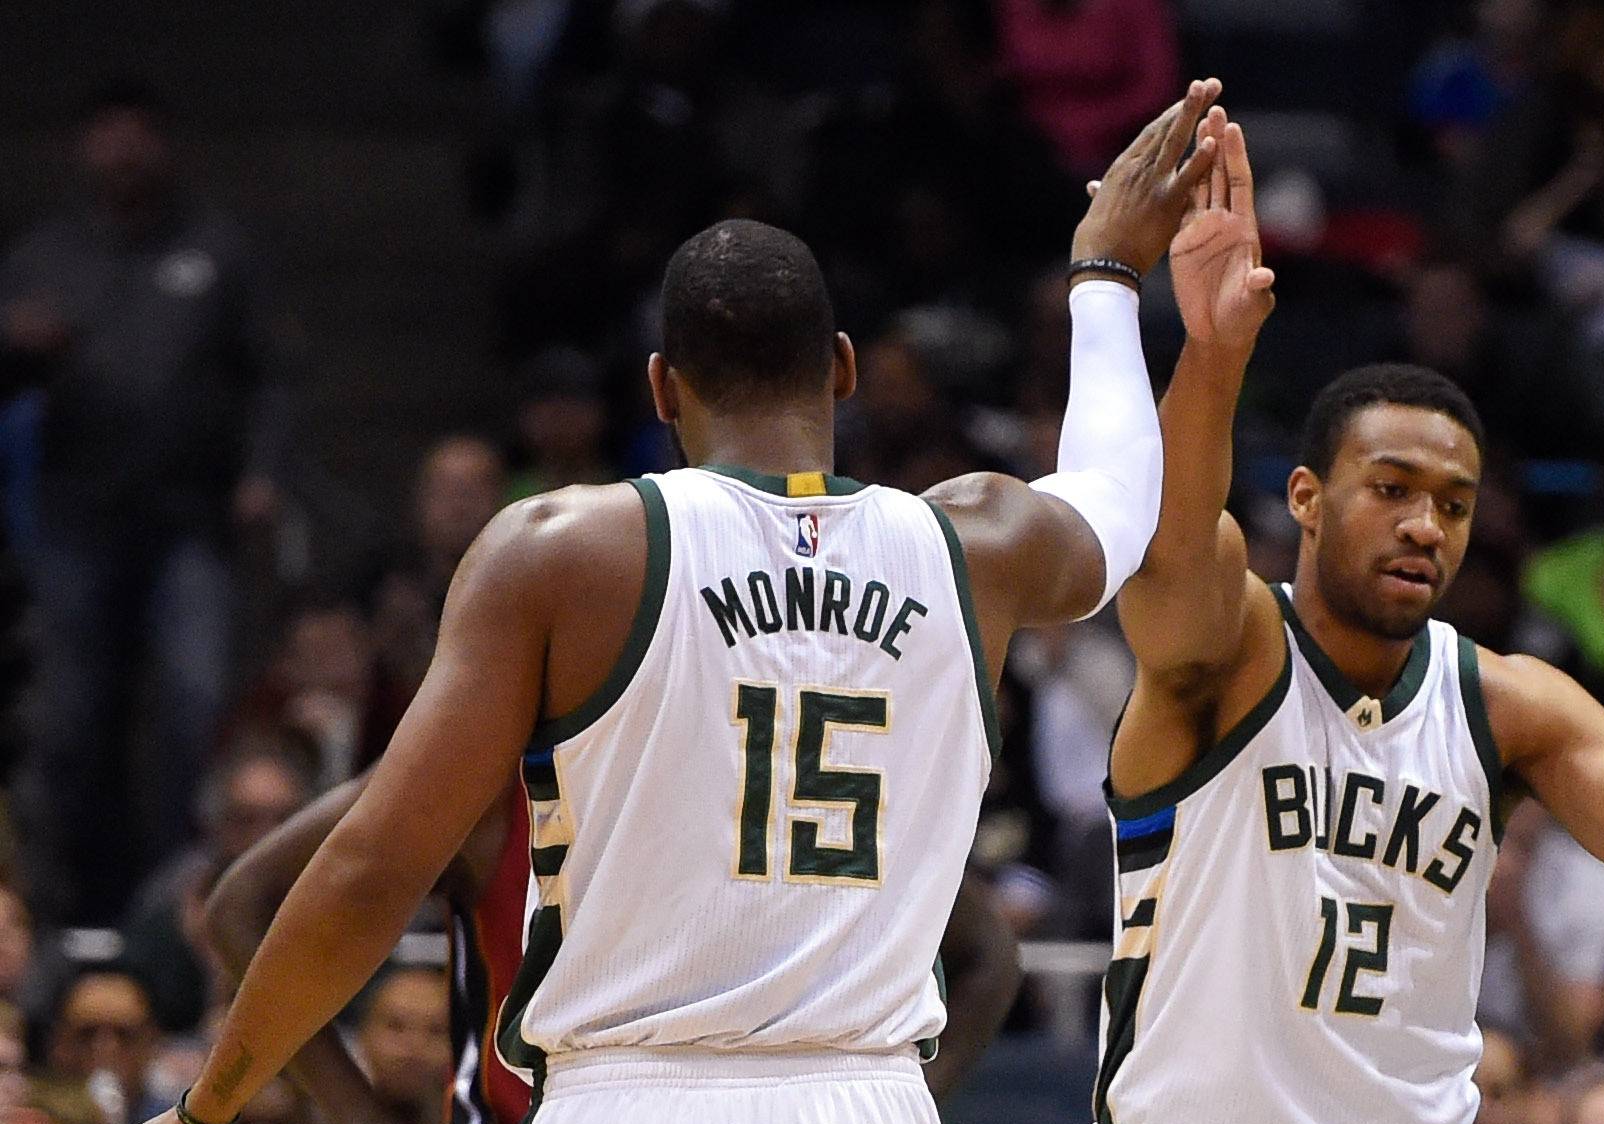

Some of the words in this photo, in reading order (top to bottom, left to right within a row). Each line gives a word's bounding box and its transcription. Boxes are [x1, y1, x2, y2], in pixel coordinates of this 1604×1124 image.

[701, 567, 928, 660] MONROE
[732, 678, 890, 887] 15
[1262, 764, 1481, 894] BUCKS
[1300, 896, 1394, 1017] 12
